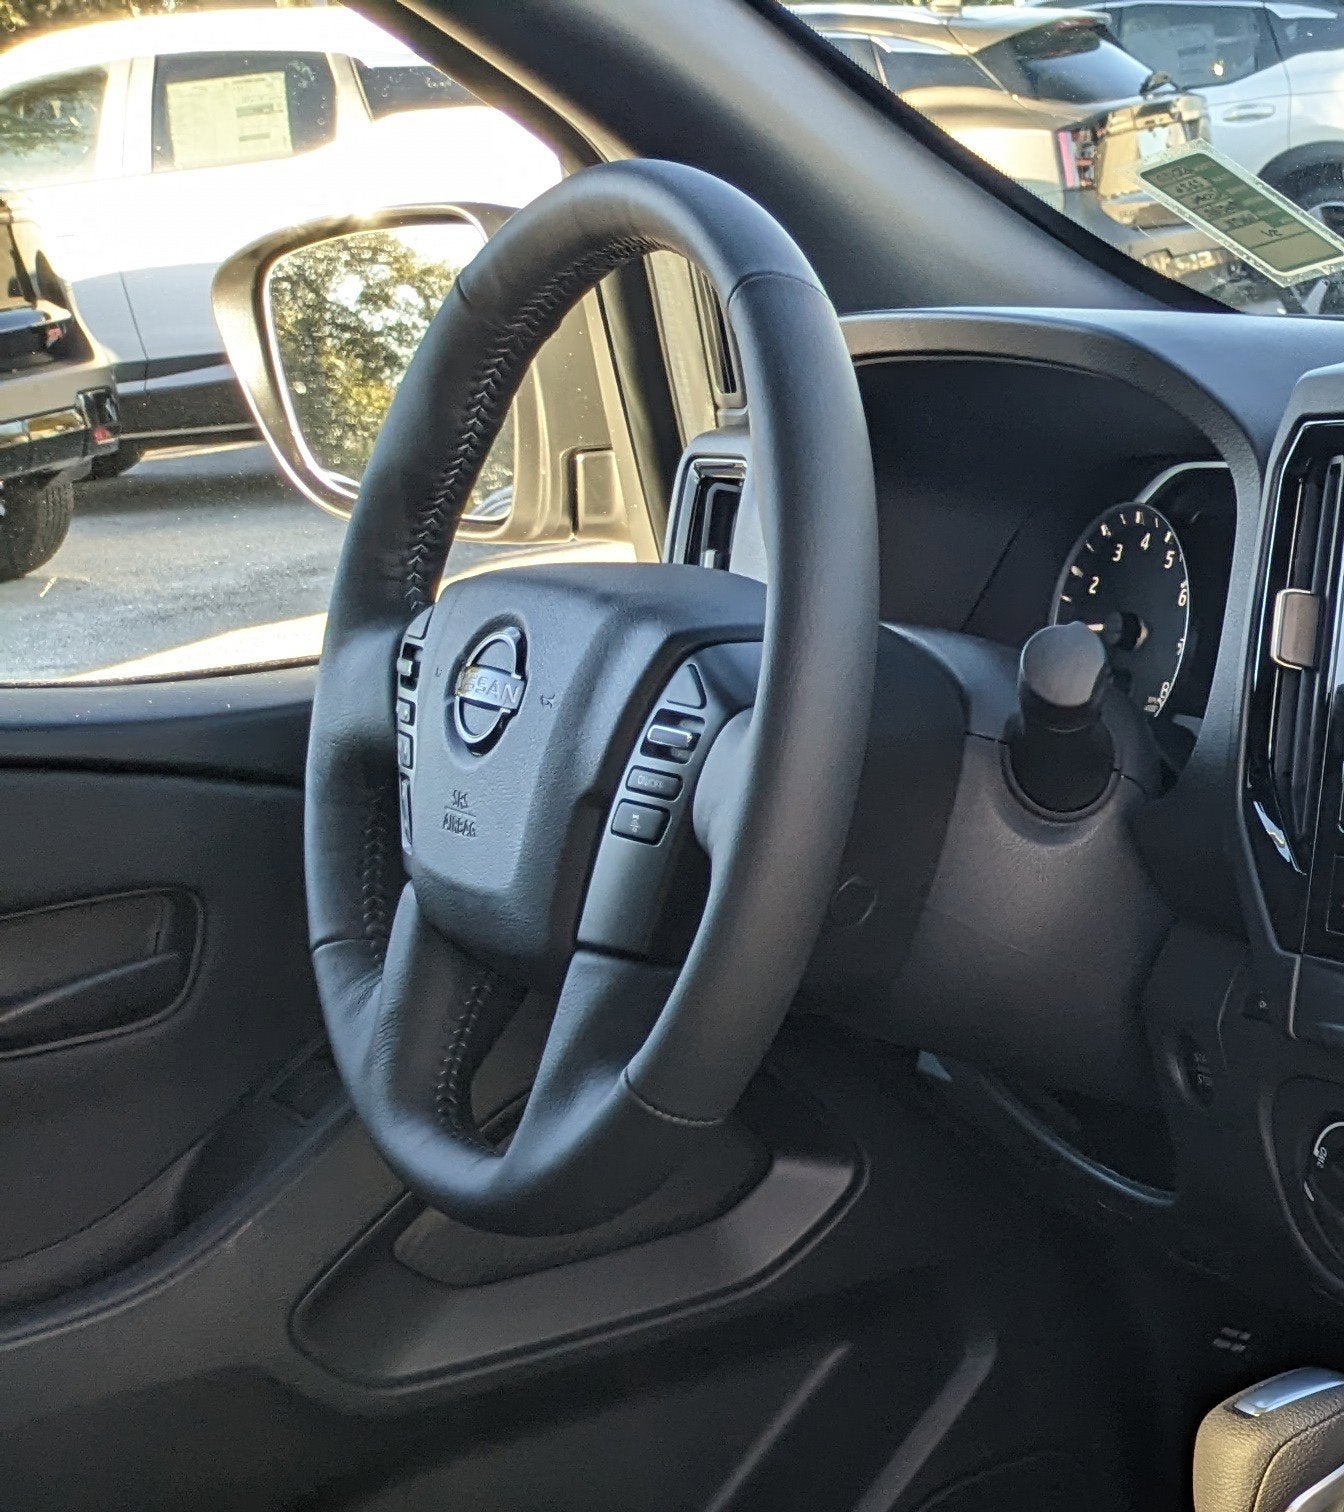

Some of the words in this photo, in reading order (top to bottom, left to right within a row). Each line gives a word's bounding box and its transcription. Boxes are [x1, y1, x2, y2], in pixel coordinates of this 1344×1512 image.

[1140, 532, 1151, 551] 4
[1112, 543, 1124, 562] 3
[1163, 550, 1176, 569] 5
[1088, 575, 1100, 595] 2
[1177, 588, 1187, 608] 6
